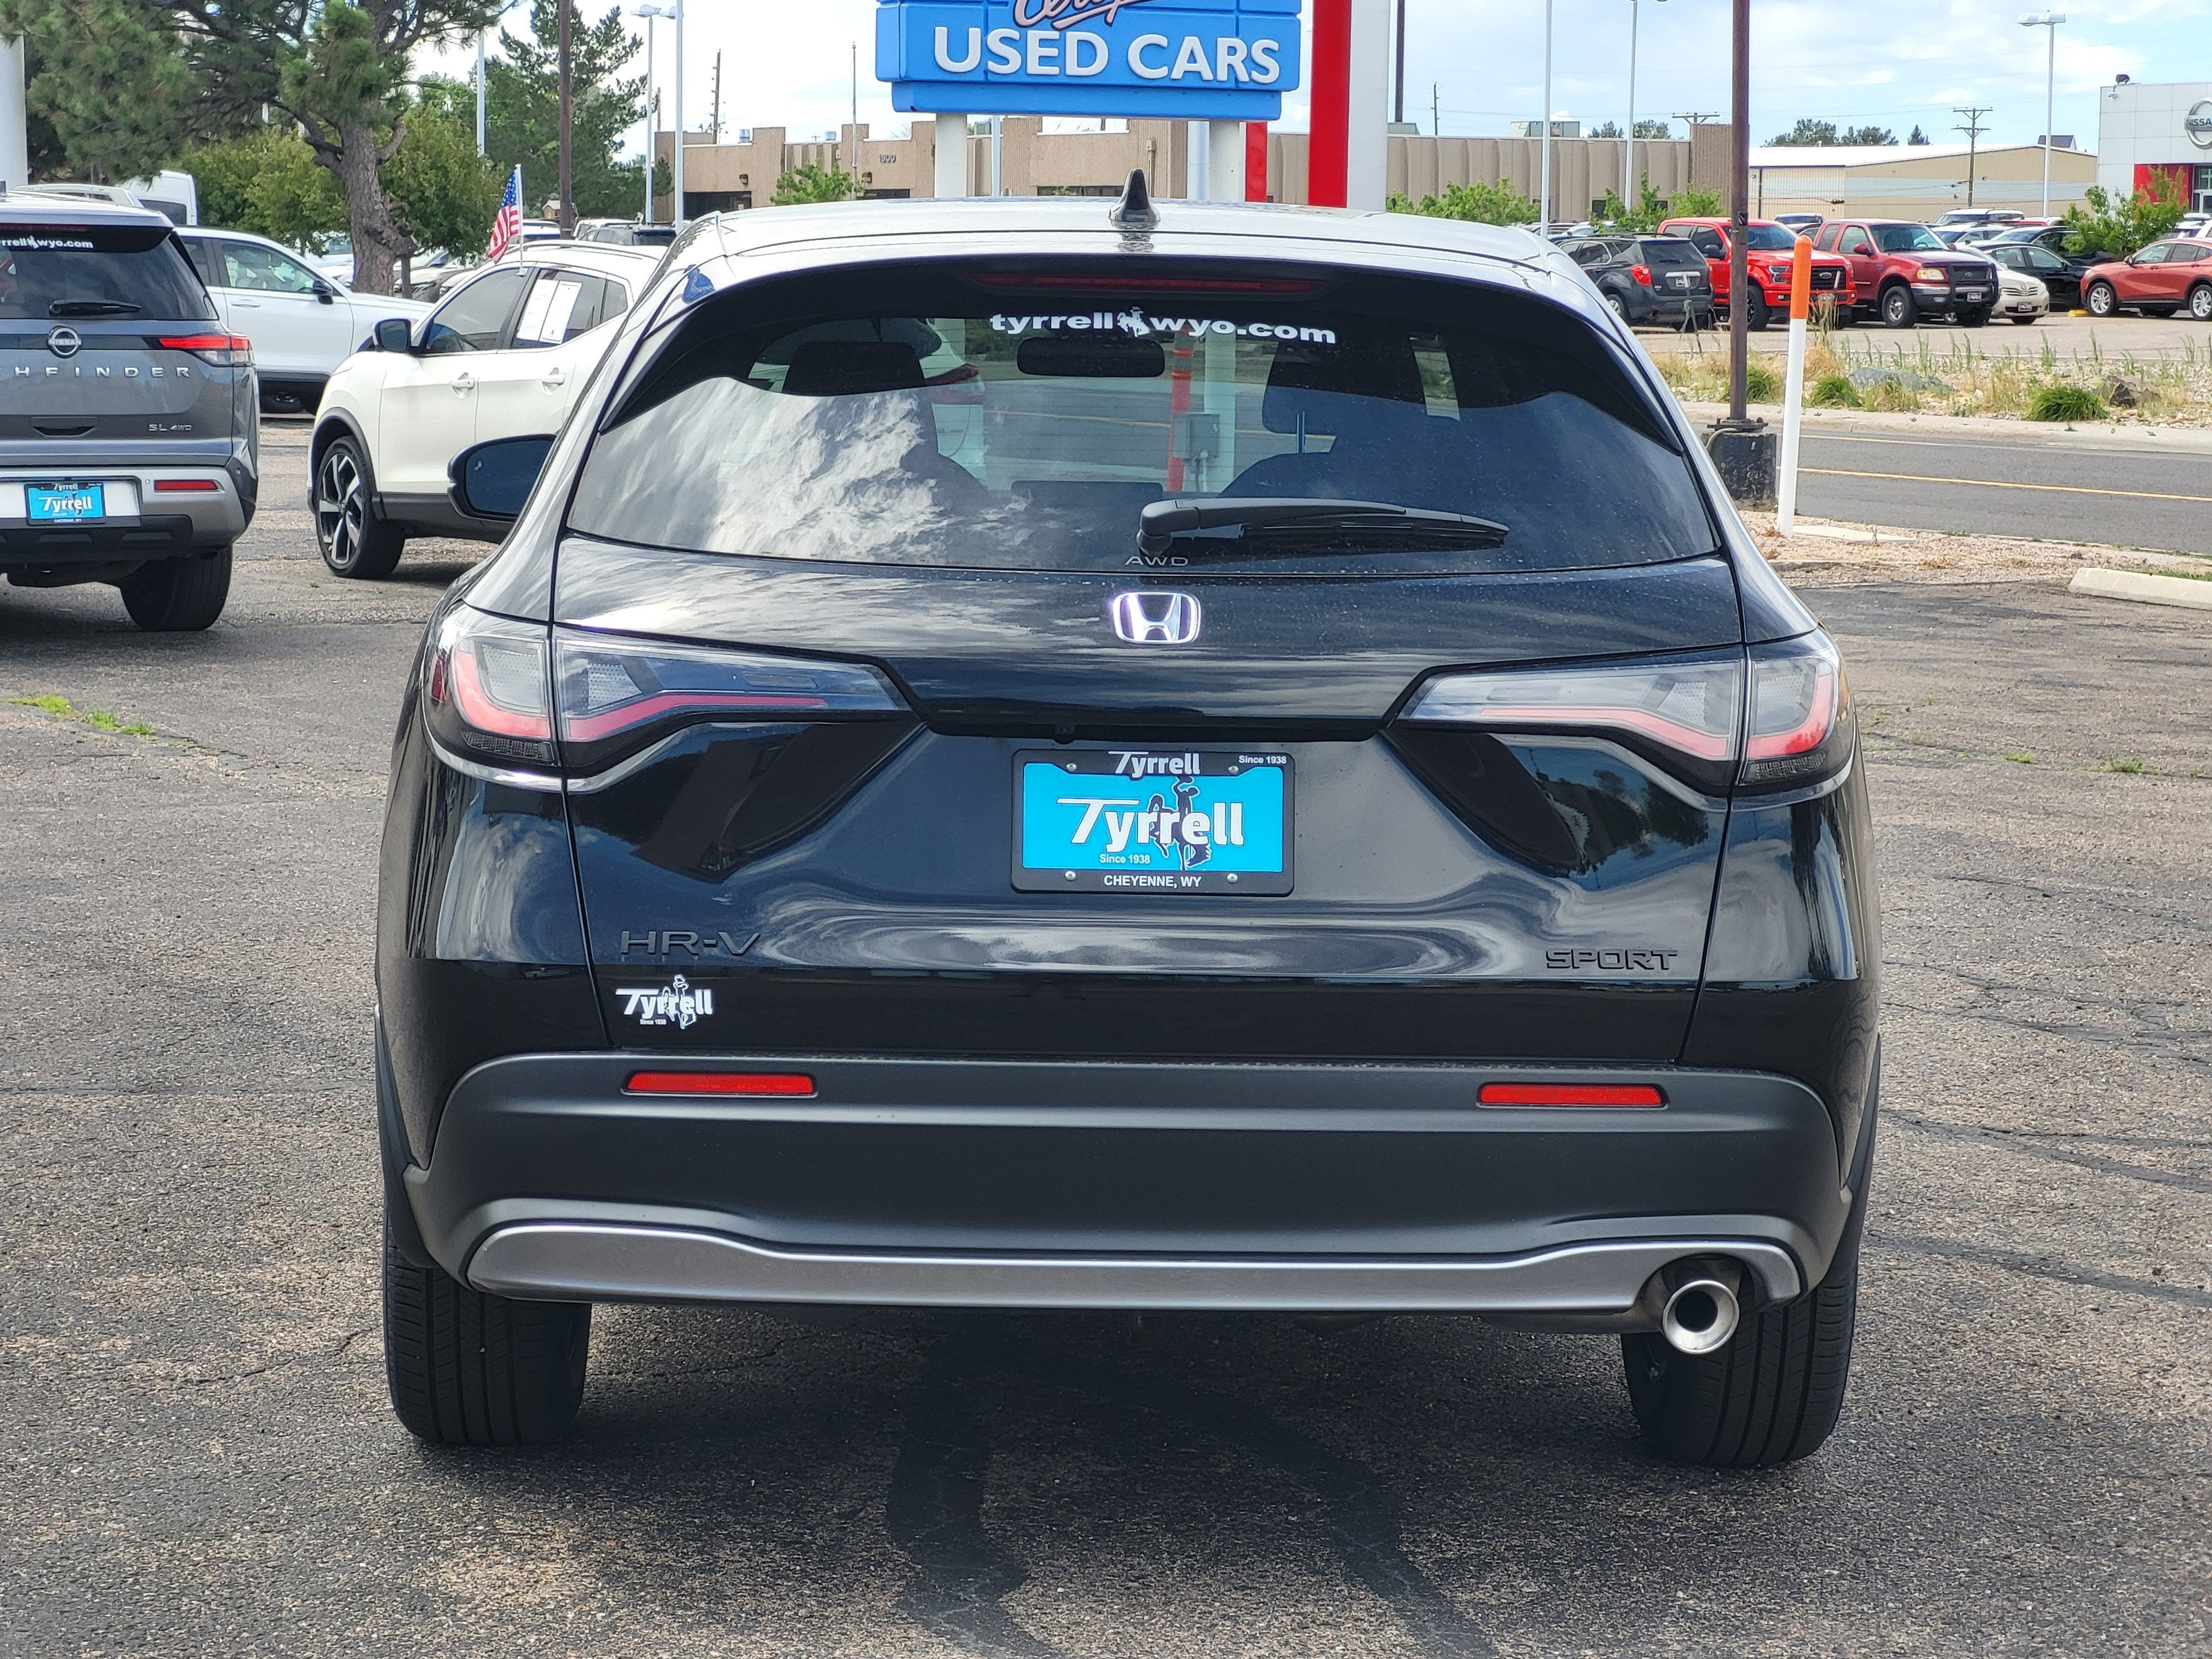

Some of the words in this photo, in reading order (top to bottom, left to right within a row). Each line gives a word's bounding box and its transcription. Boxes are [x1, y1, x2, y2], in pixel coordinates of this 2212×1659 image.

[934, 27, 1107, 76] USED
[1127, 34, 1280, 84] CARS
[0, 238, 27, 247] rrell
[36, 239, 94, 249] wyo.com
[0, 366, 191, 378] HFINDER
[38, 496, 92, 513] Tyrrell
[1124, 555, 1189, 567] AWD
[1108, 750, 1201, 779] Tyrrell
[1238, 755, 1264, 764] Since
[1266, 755, 1287, 765] 1938
[1056, 797, 1245, 853] Tyrrell
[1099, 853, 1126, 864] Since
[1128, 854, 1151, 864] 1938
[1103, 875, 1178, 889] CHEYENNE,
[1181, 877, 1202, 888] WY
[620, 930, 761, 956] HR-V
[1545, 948, 1678, 971] SPORT
[615, 988, 714, 1019] Tyrrell
